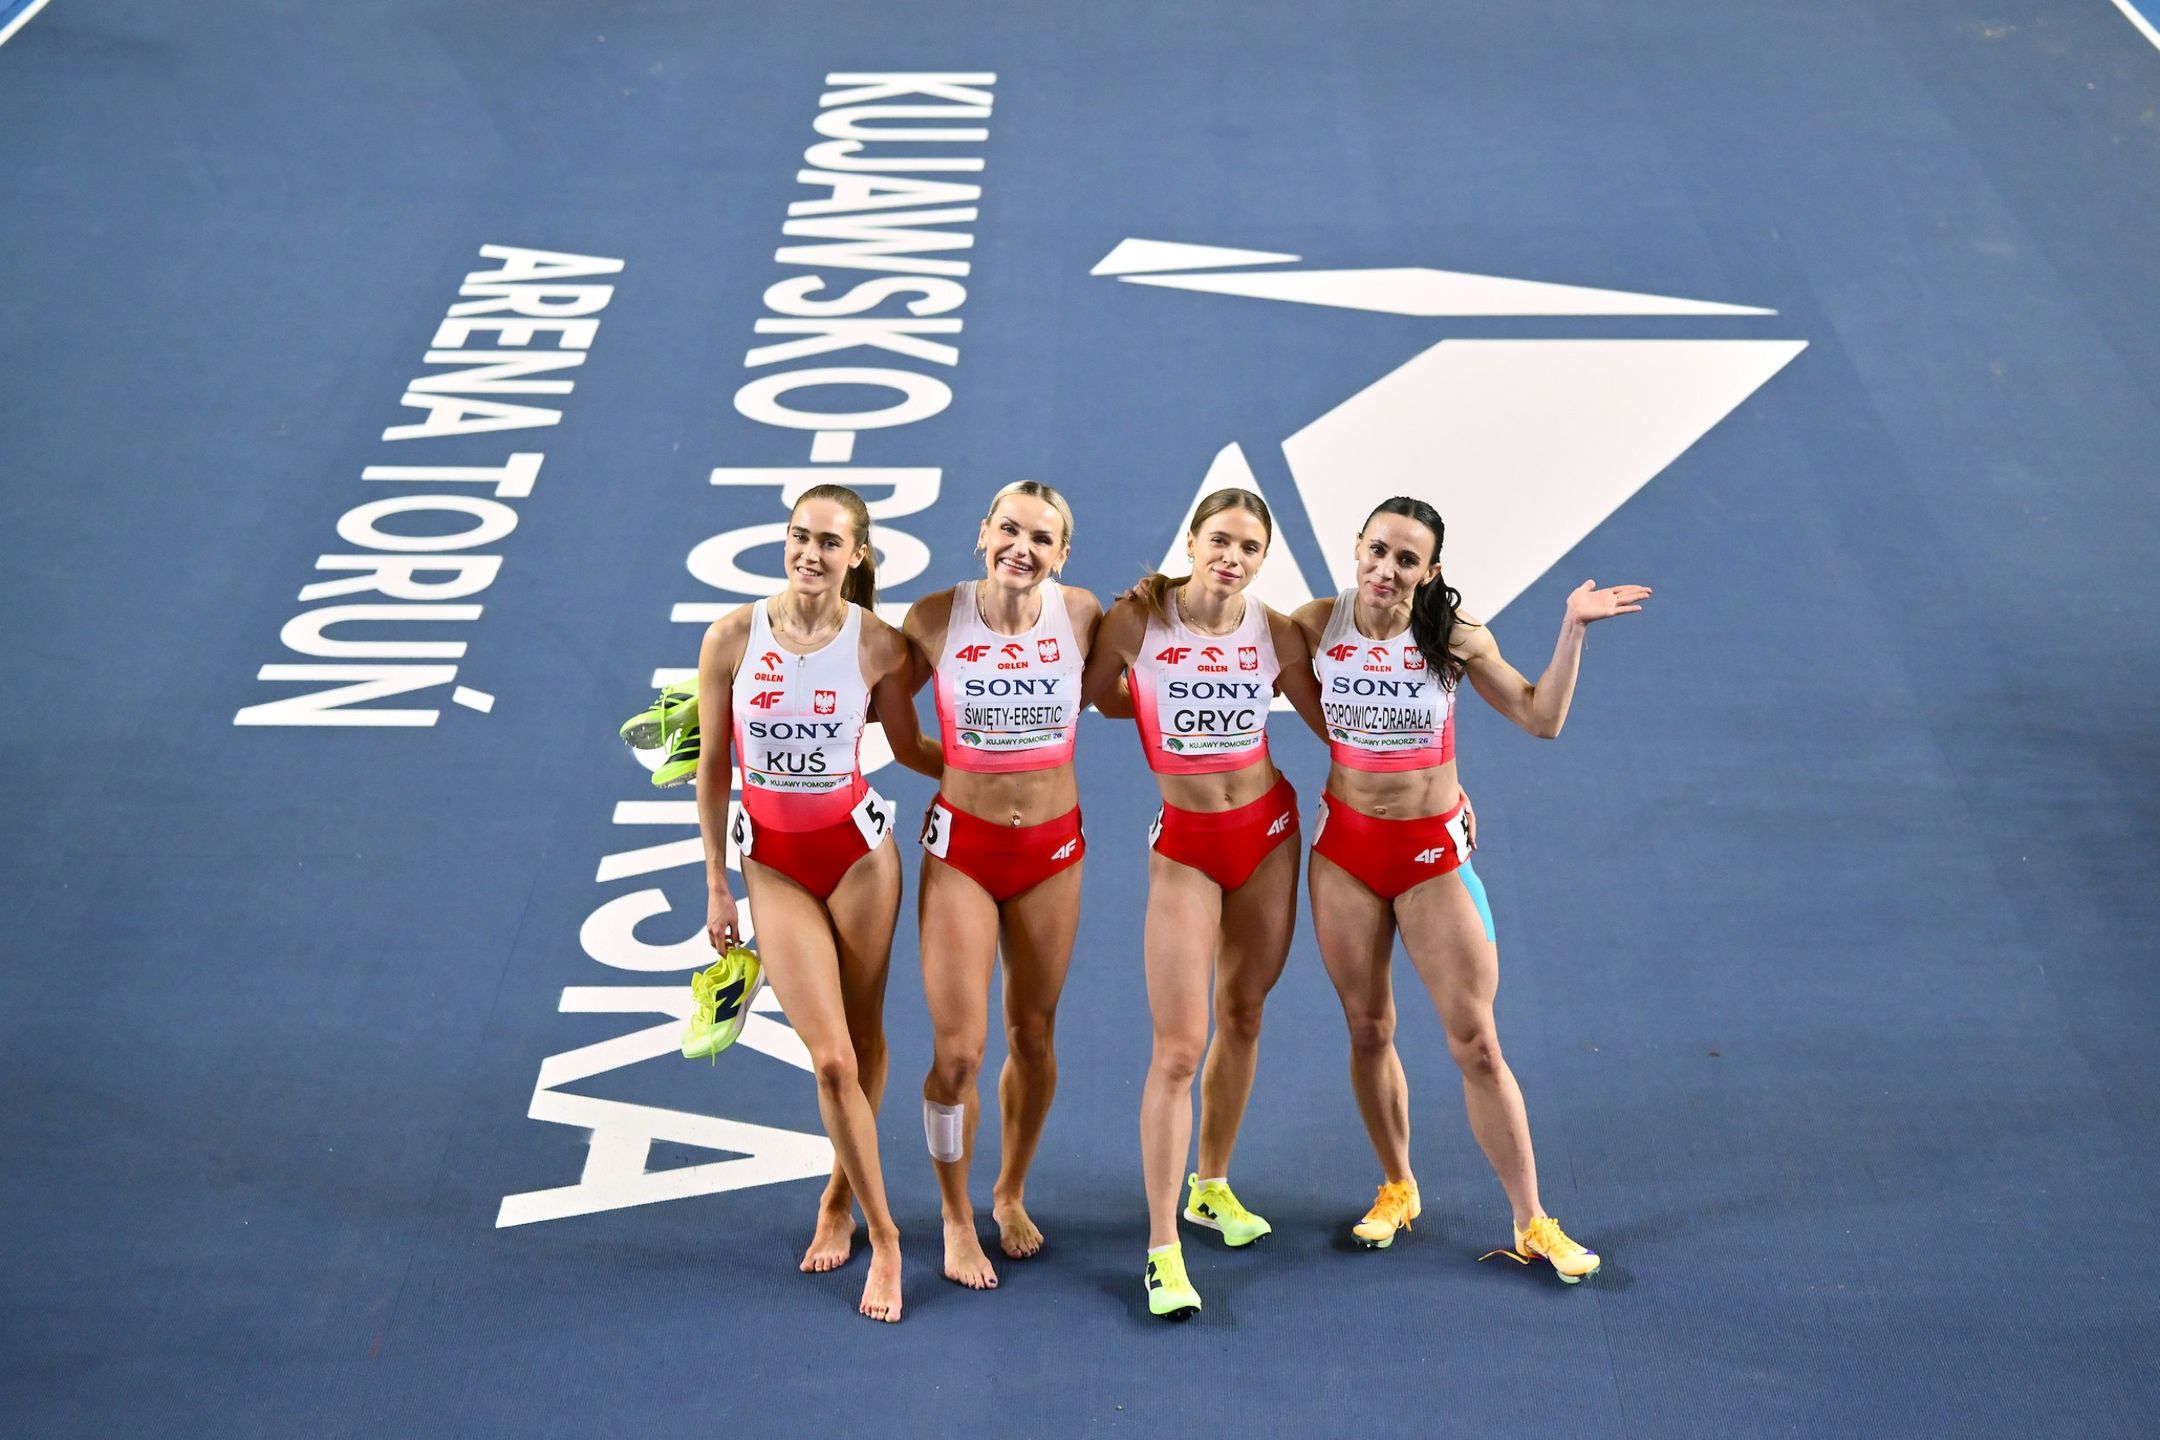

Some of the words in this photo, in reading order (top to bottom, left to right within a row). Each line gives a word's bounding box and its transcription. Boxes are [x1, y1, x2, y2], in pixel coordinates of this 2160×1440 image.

[382, 244, 625, 441] ARENA
[233, 453, 545, 727] TORUŃ
[955, 644, 992, 662] 4F
[1155, 646, 1192, 665] 4F
[1326, 643, 1358, 662] 4F
[997, 661, 1029, 670] ORLEN
[1197, 665, 1228, 673] ORLEN
[1363, 664, 1392, 673] ORLEN
[754, 672, 784, 683] ORLEN
[965, 679, 1060, 697] SONY
[1168, 681, 1261, 699] SONY
[1332, 676, 1426, 698] SONY
[749, 691, 785, 709] 4F
[964, 703, 1063, 731] ŚWIĘTY-ERSETIC
[1174, 709, 1255, 733] GRYC
[749, 721, 844, 740] SONY
[986, 738, 1017, 746] KUJAWY
[1018, 734, 1052, 745] POMORZE
[1189, 740, 1219, 749] KUJAWY
[1353, 735, 1380, 746] KUJAWY
[1381, 738, 1417, 746] POMORZE
[766, 747, 827, 773] KUŚ
[770, 779, 800, 788] KUJAWY
[865, 800, 886, 836] 5
[1266, 811, 1290, 837] 4F
[926, 812, 941, 845] 5
[1050, 838, 1077, 861] 4F
[1414, 847, 1445, 864] 4F
